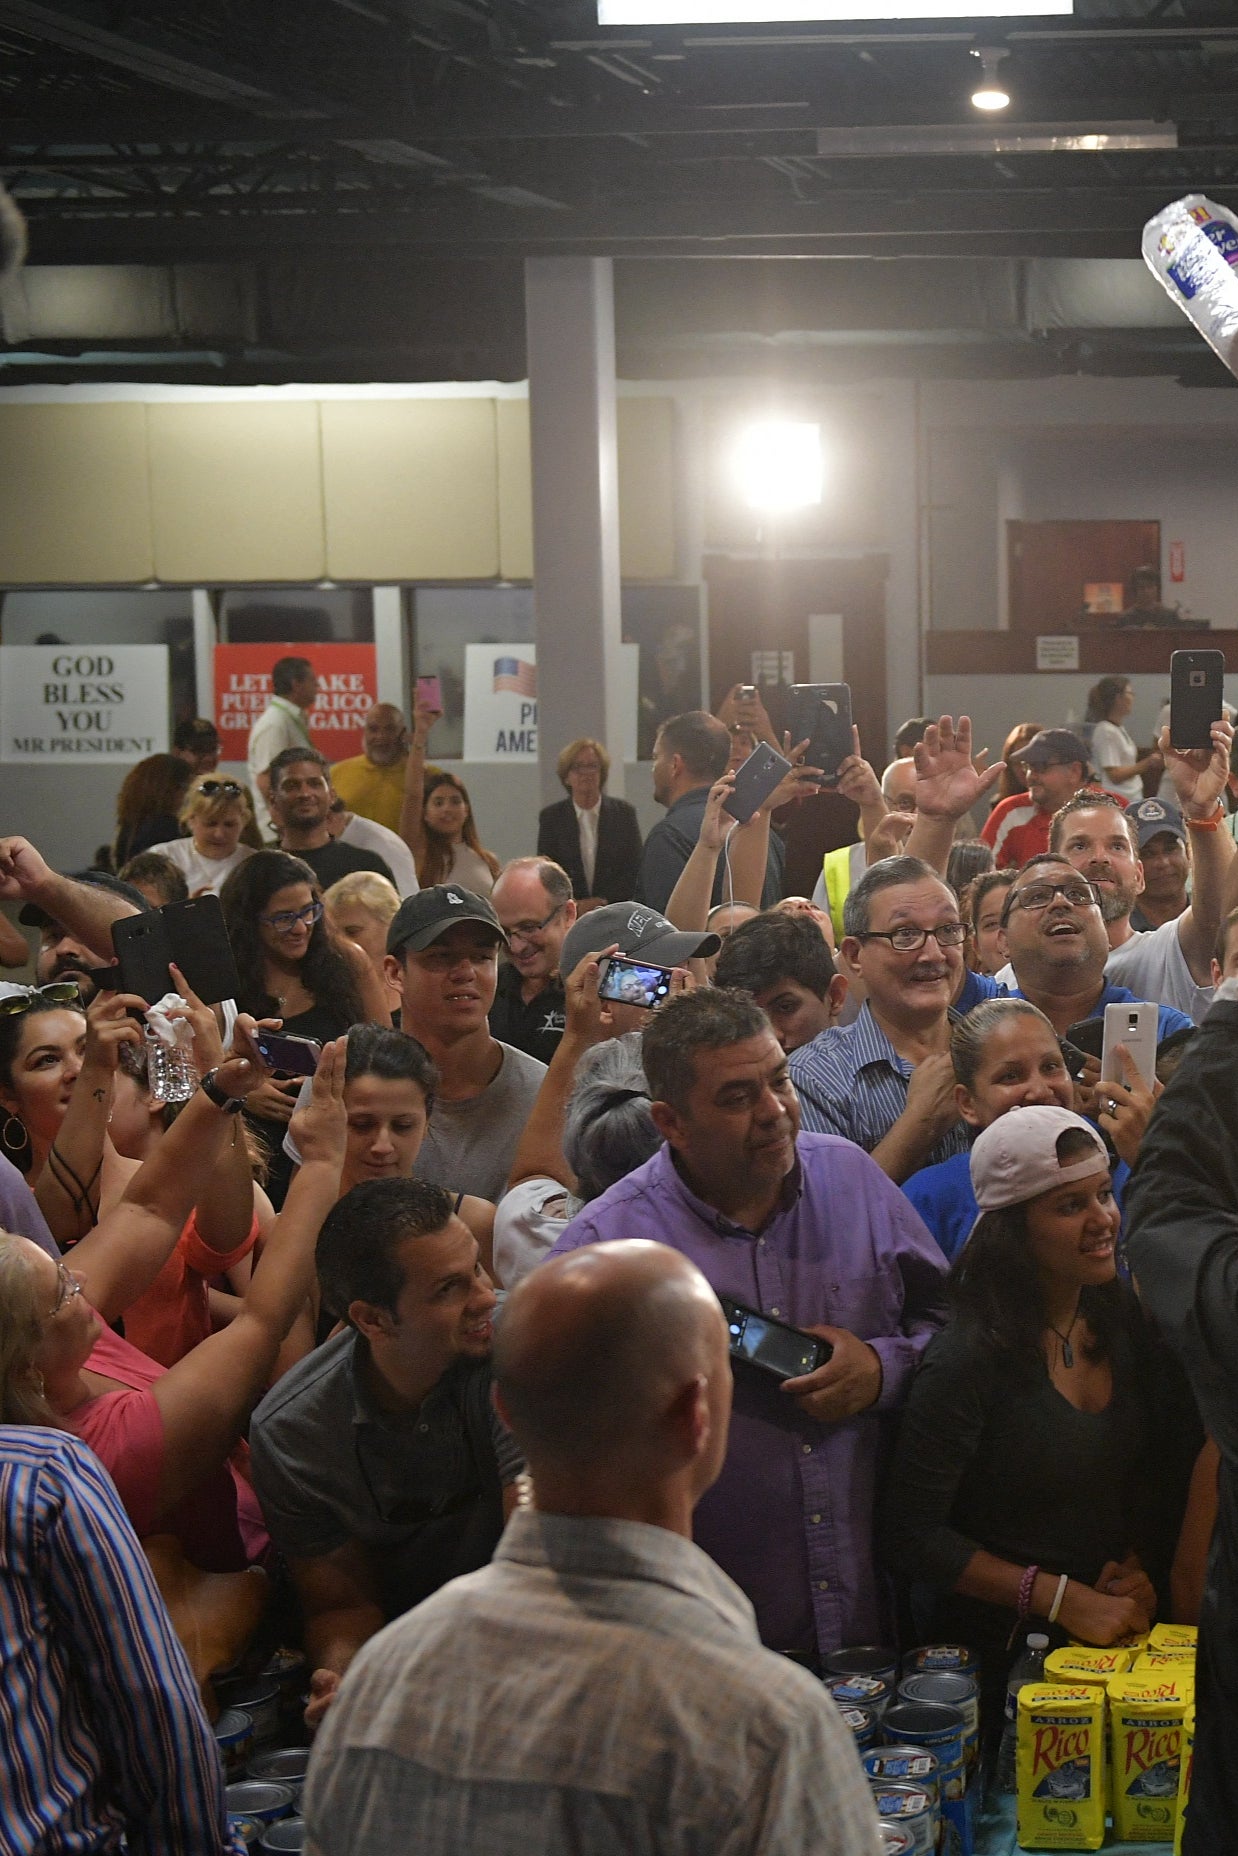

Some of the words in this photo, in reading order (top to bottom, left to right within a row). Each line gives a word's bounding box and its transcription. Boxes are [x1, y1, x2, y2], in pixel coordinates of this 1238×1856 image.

[52, 655, 114, 676] GOD
[43, 682, 125, 704] BLESS
[230, 674, 272, 692] LET
[316, 674, 365, 692] AKE
[221, 693, 273, 711] PUE
[314, 693, 373, 712] RICO
[55, 709, 112, 732] YOU
[309, 713, 368, 730] GAIN
[14, 737, 44, 752] MR
[50, 737, 155, 752] PRESIDENT
[1033, 1725, 1090, 1777] Rico
[1124, 1728, 1181, 1775] Rico
